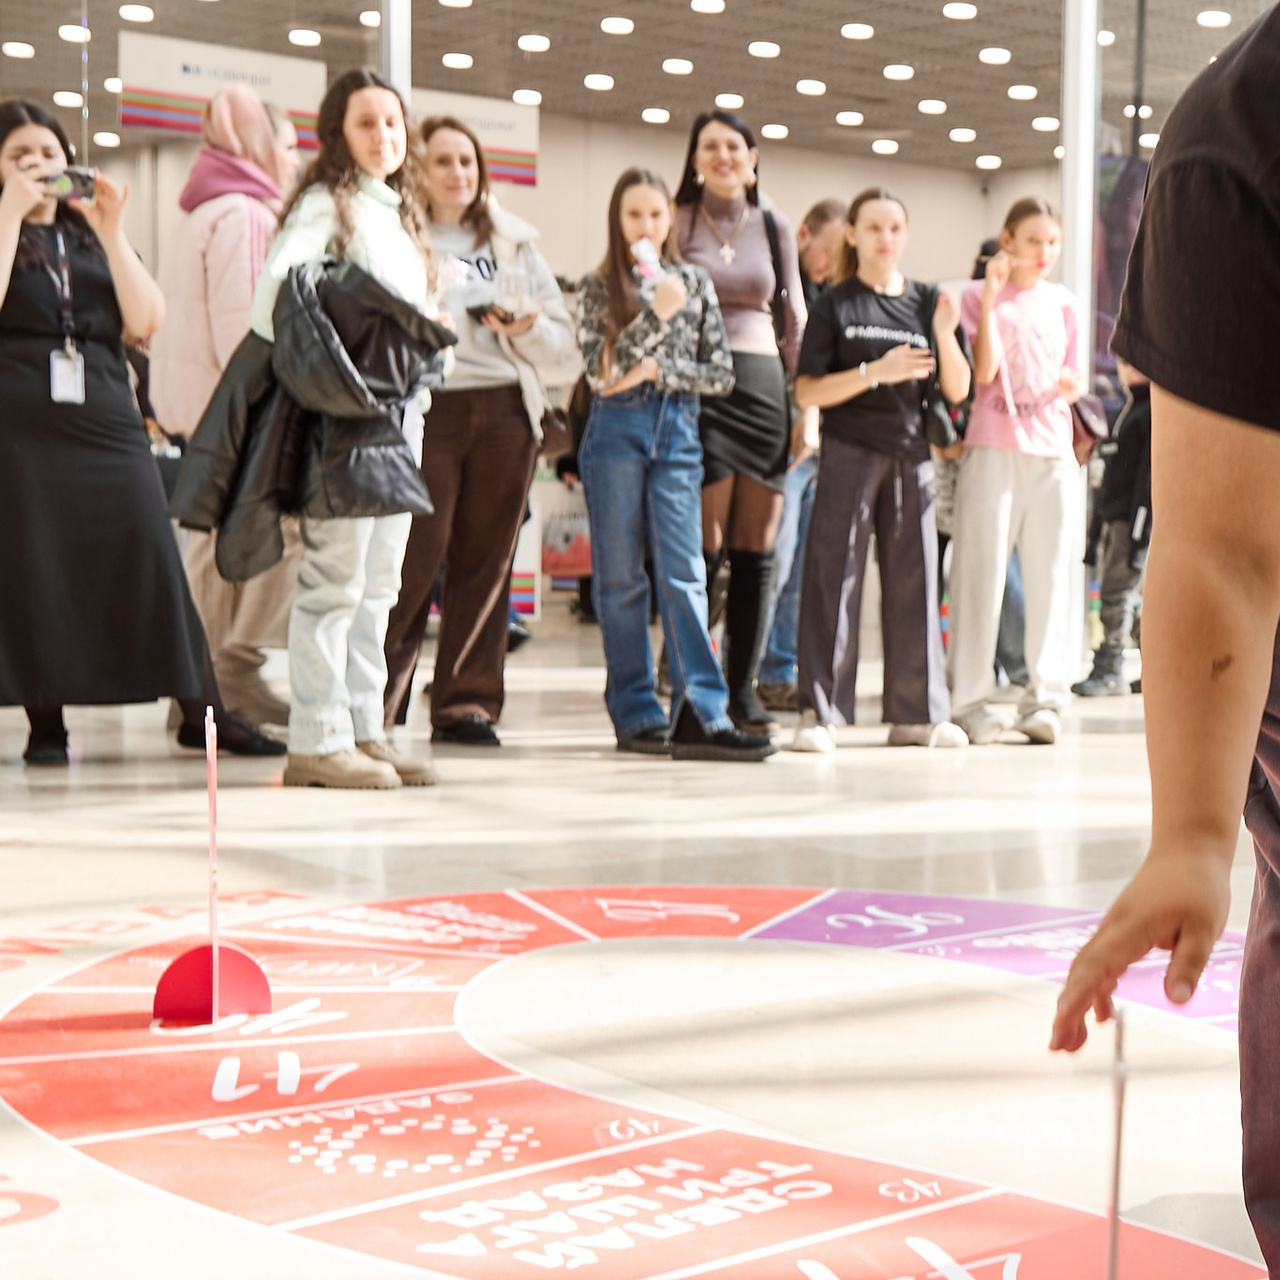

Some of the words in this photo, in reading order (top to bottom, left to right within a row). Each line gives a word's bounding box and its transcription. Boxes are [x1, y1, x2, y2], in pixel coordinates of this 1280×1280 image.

[211, 1050, 360, 1102] 41
[198, 1091, 474, 1140] ЗАДАНИЕ
[419, 1157, 704, 1228] НАЗАД
[655, 1160, 814, 1202] ТРИ
[876, 1176, 943, 1204] 43
[416, 1193, 663, 1257] ШАГА
[512, 1179, 834, 1270] СДЕЛАЙ
